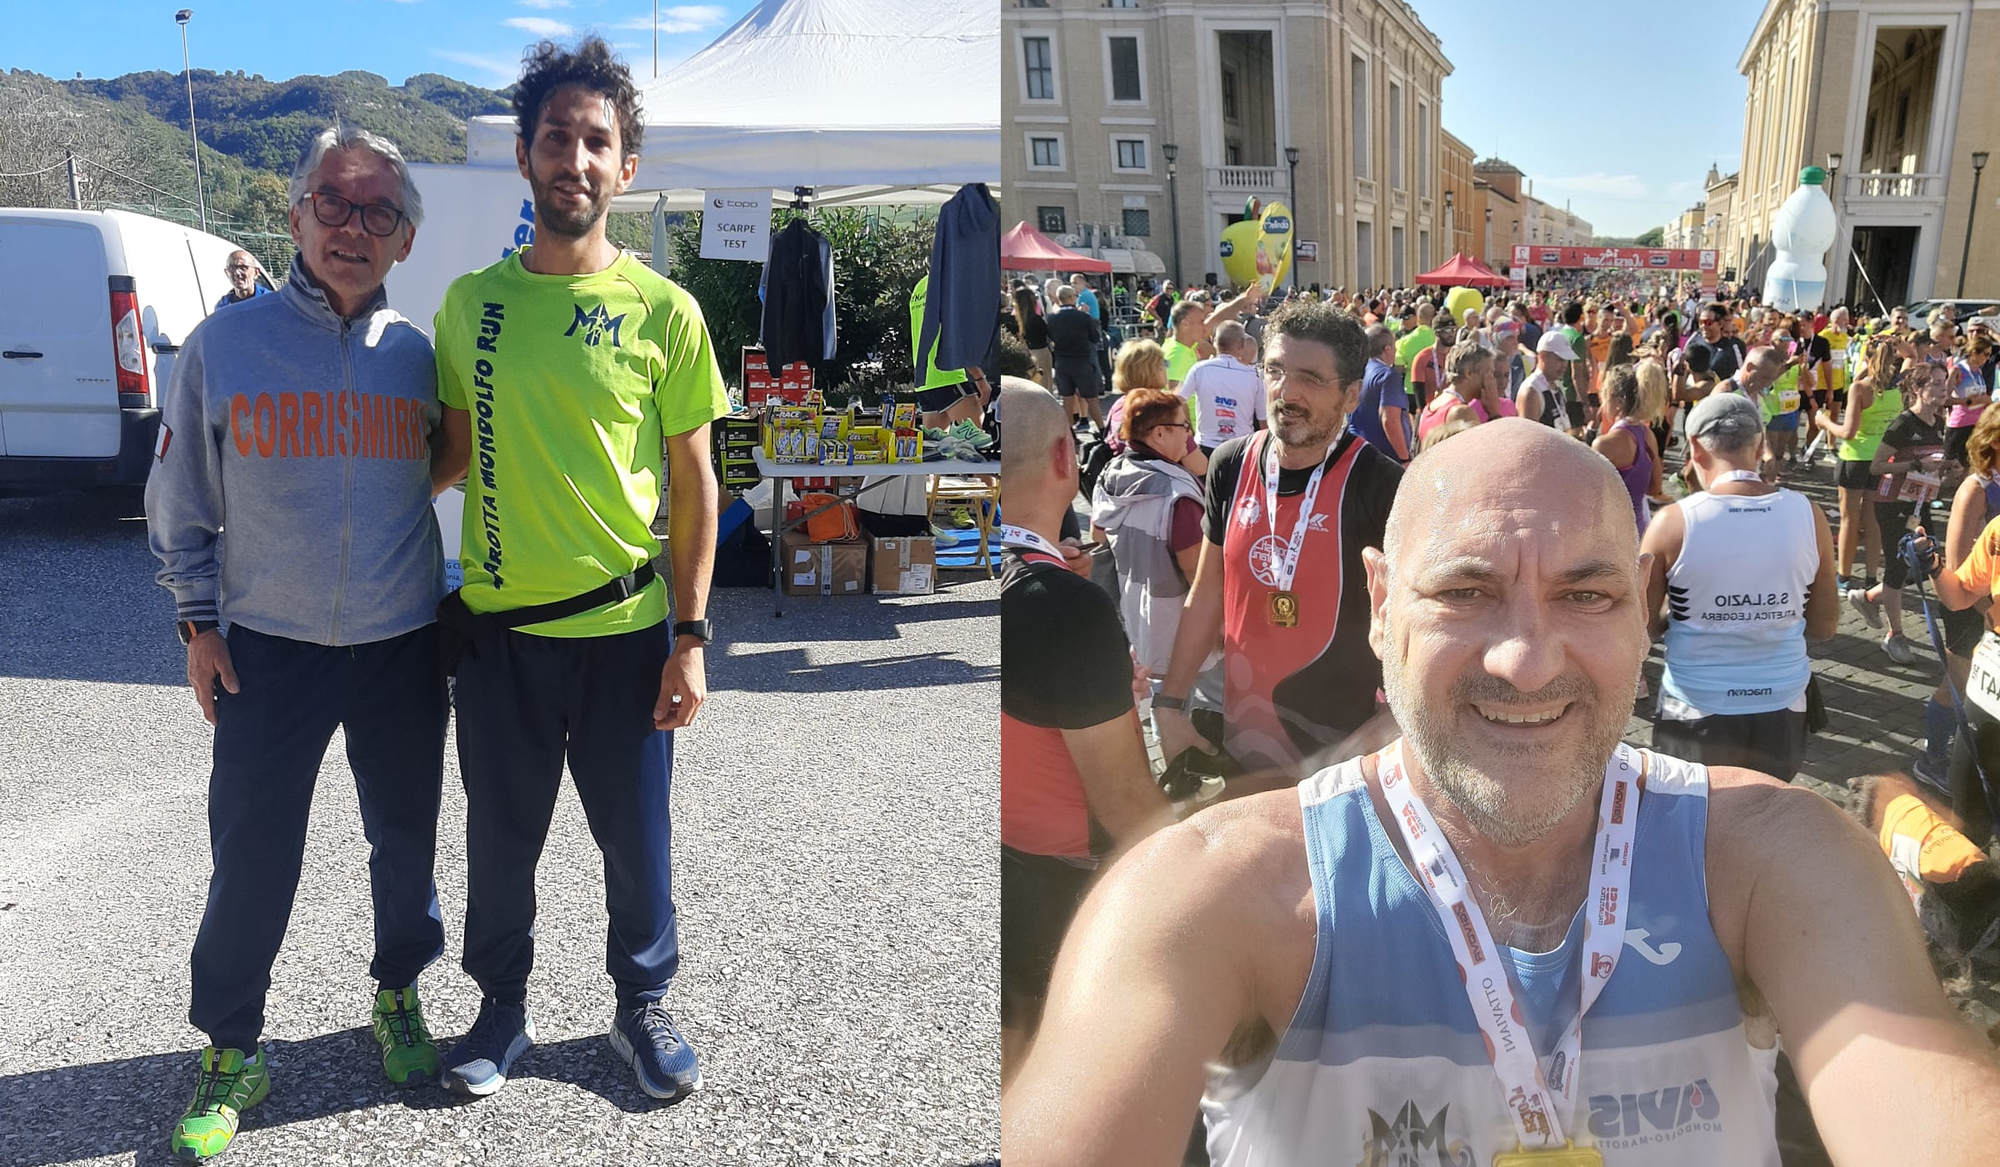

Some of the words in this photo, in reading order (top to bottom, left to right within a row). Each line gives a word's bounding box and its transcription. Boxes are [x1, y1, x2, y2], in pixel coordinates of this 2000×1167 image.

[717, 223, 756, 234] SCARPE
[723, 239, 747, 249] TEST
[476, 302, 505, 353] RUN
[474, 358, 499, 490] MONDOLFO
